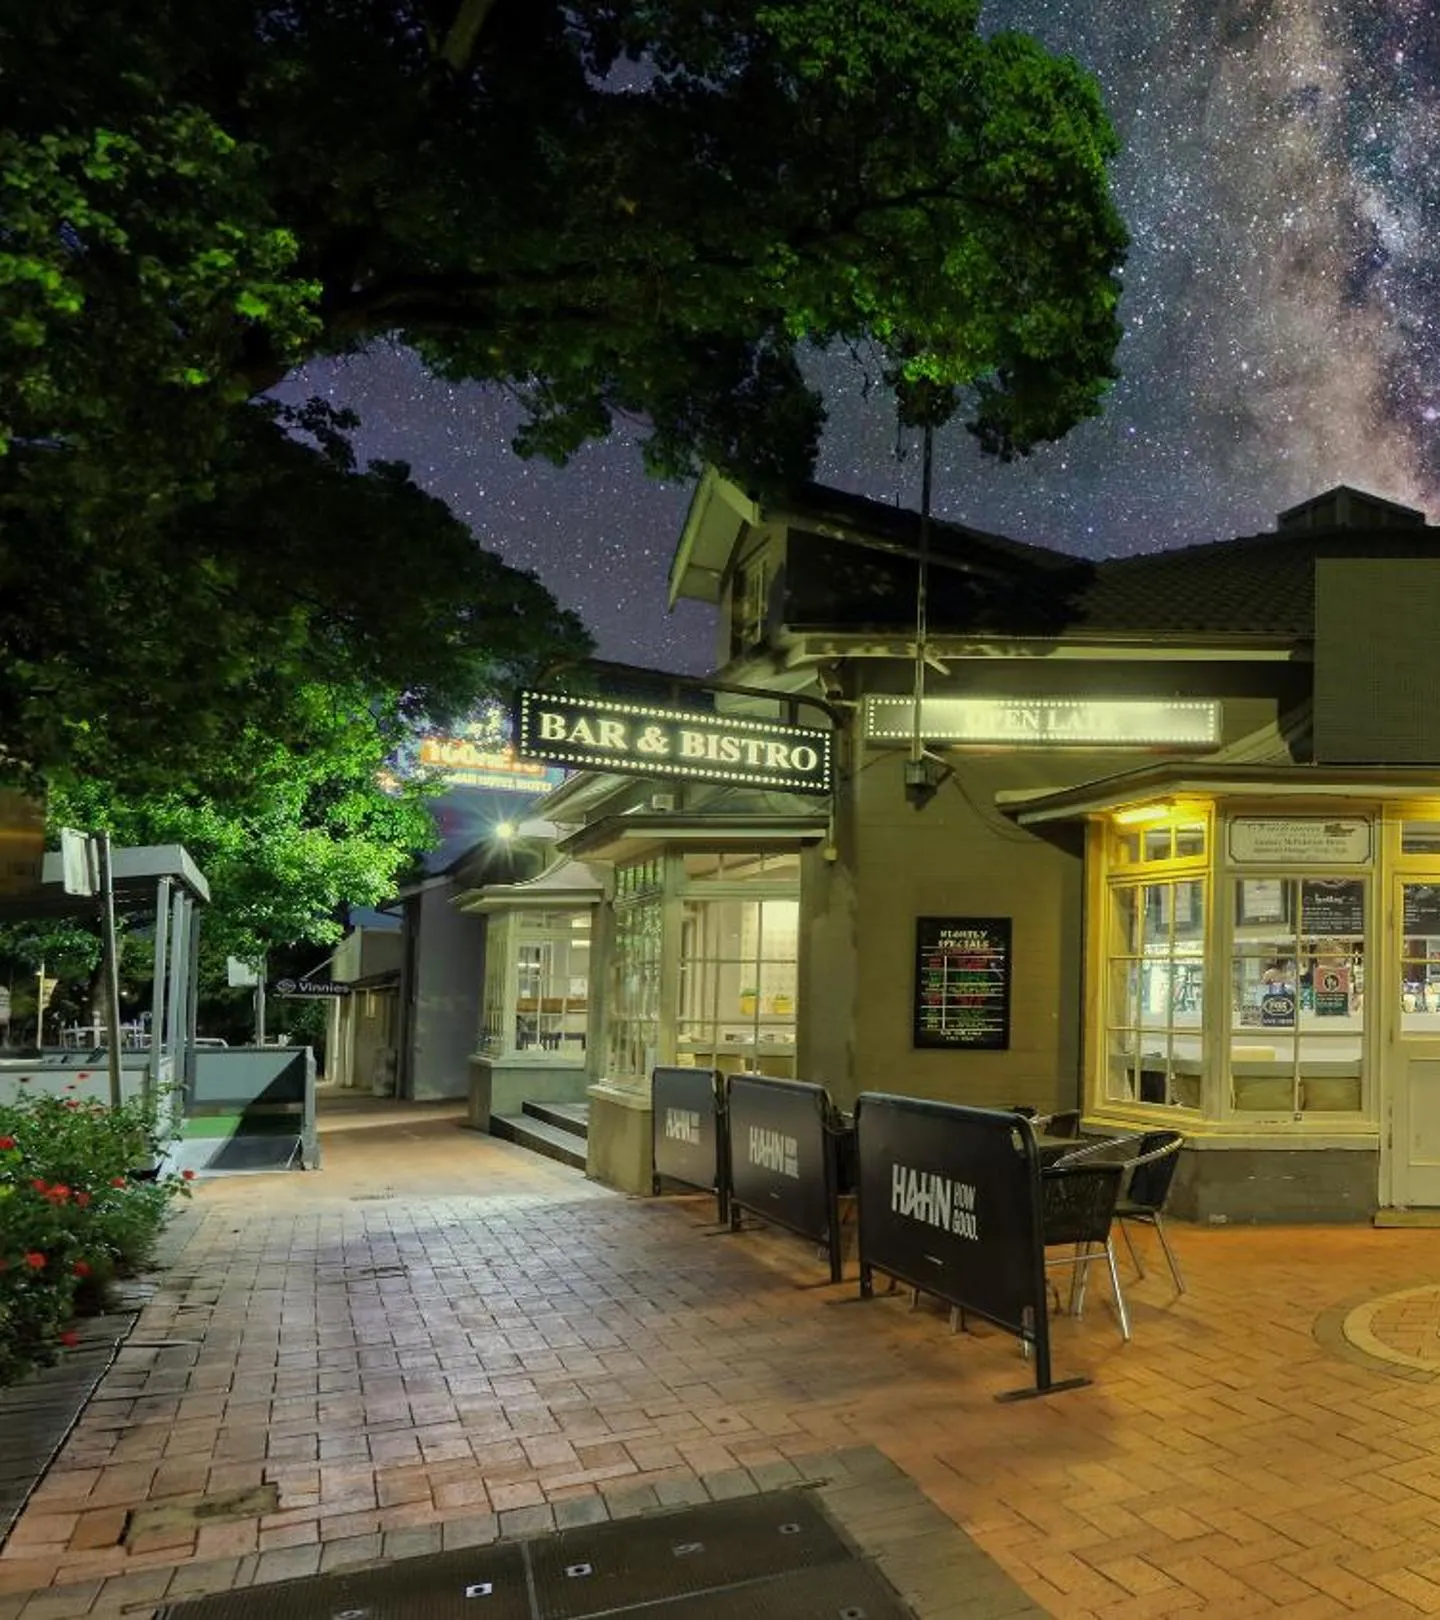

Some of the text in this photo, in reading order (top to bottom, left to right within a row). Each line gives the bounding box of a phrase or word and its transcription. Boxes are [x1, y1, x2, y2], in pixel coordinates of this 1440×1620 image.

[540, 712, 818, 772] BAR & BISTRO
[299, 982, 349, 993] Vinnies
[665, 1107, 691, 1143] HAHN
[750, 1126, 785, 1173] HAHN
[892, 1163, 951, 1232] HAHN
[953, 1181, 976, 1210] HOW
